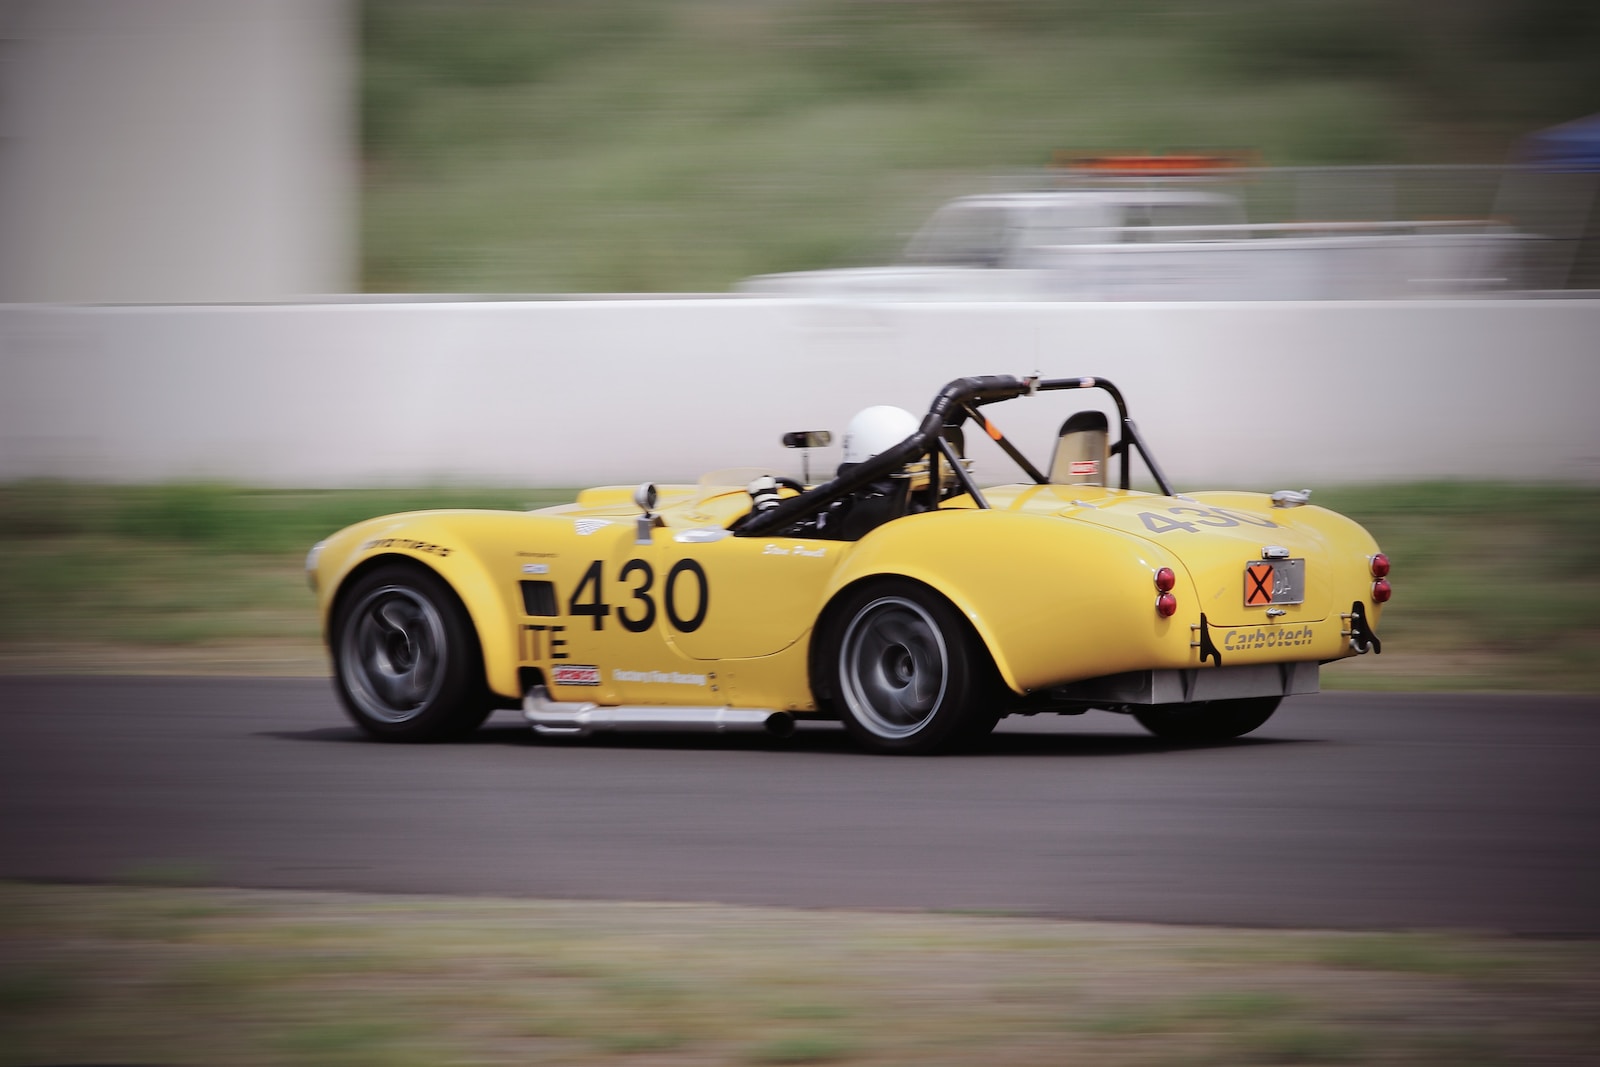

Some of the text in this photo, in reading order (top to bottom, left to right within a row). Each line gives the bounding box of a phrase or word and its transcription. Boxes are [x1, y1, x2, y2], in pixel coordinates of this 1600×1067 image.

[1137, 507, 1279, 533] 430
[569, 558, 709, 633] 430
[519, 624, 569, 662] ITE
[1224, 625, 1313, 651] Carbotech
